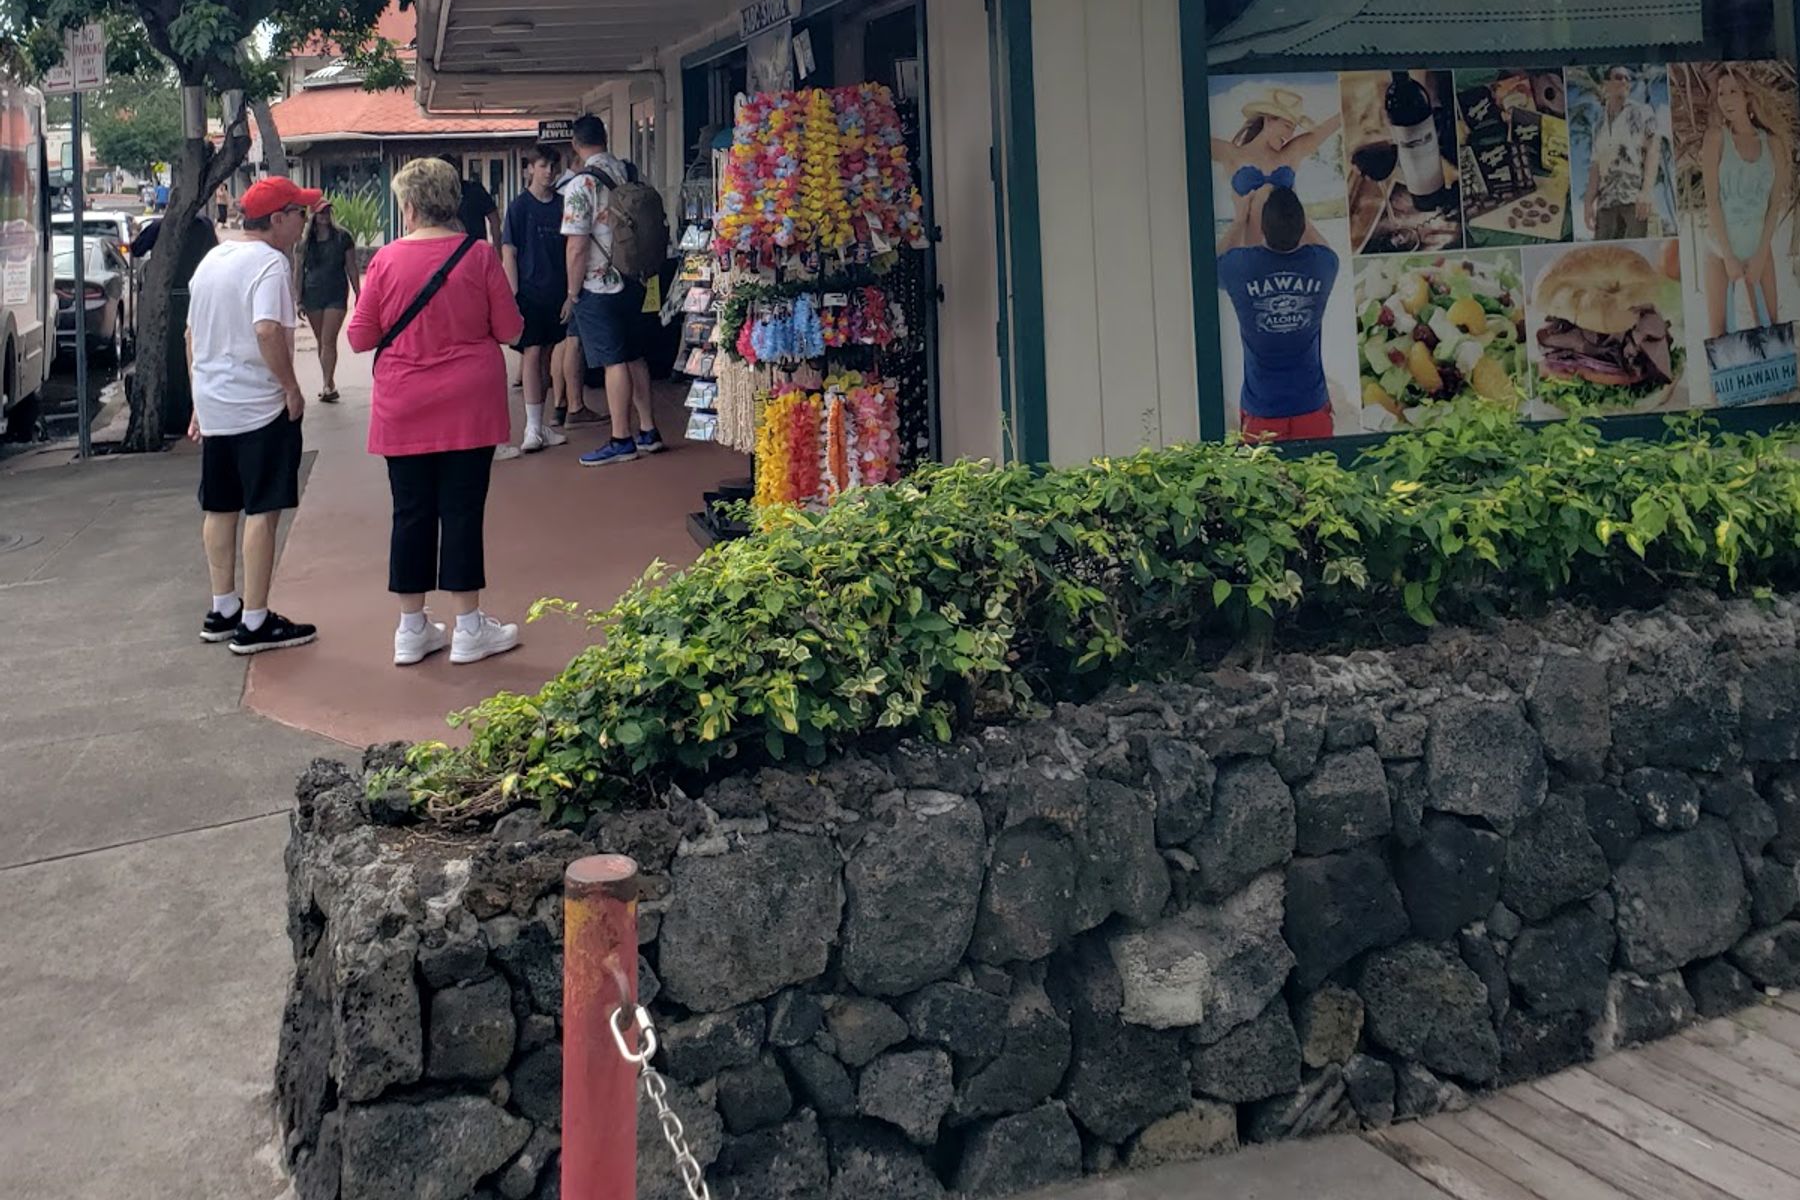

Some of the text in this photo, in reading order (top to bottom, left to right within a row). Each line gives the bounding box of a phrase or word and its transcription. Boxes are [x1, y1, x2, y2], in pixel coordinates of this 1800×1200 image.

[82, 29, 94, 43] NO
[75, 43, 102, 56] PARKING
[1247, 276, 1321, 296] HAWAII
[1266, 314, 1303, 325] ALOHA
[1736, 367, 1779, 390] HAWAII
